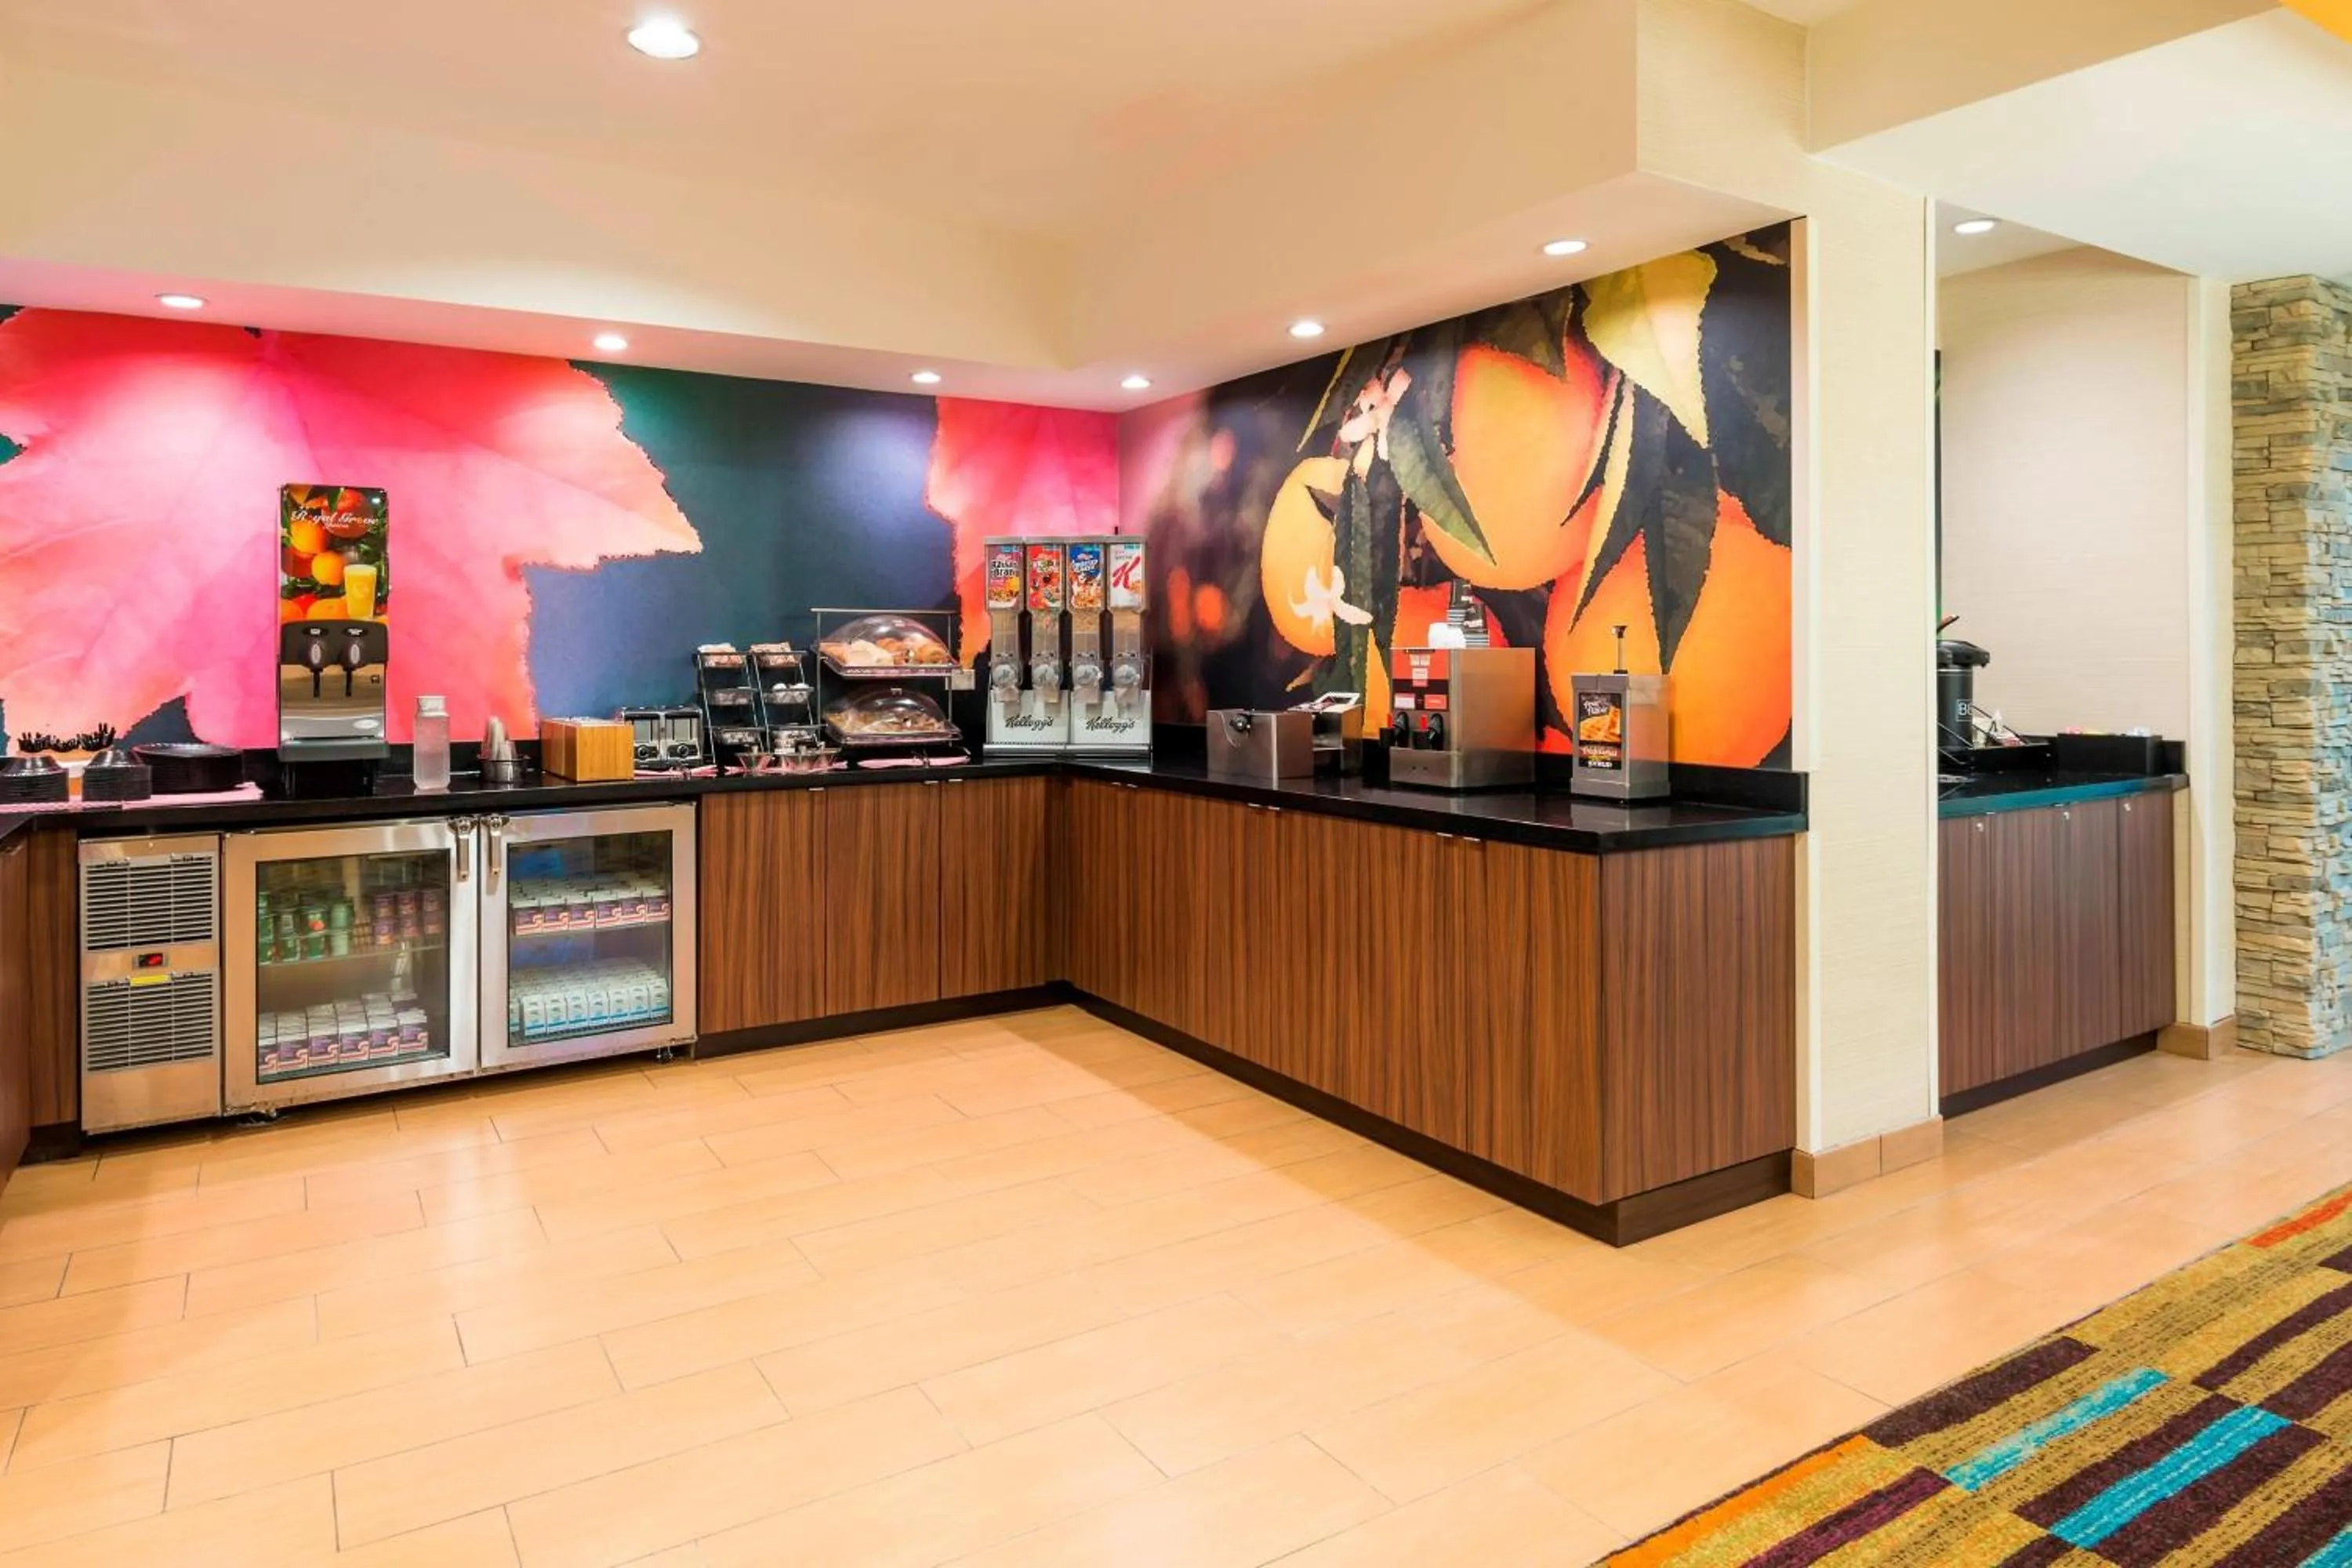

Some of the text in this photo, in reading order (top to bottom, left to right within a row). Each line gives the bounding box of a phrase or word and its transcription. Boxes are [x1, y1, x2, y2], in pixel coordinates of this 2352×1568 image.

[1112, 555, 1142, 588] K
[1004, 714, 1054, 731] Kellogg's
[1085, 716, 1136, 733] Kellogg's
